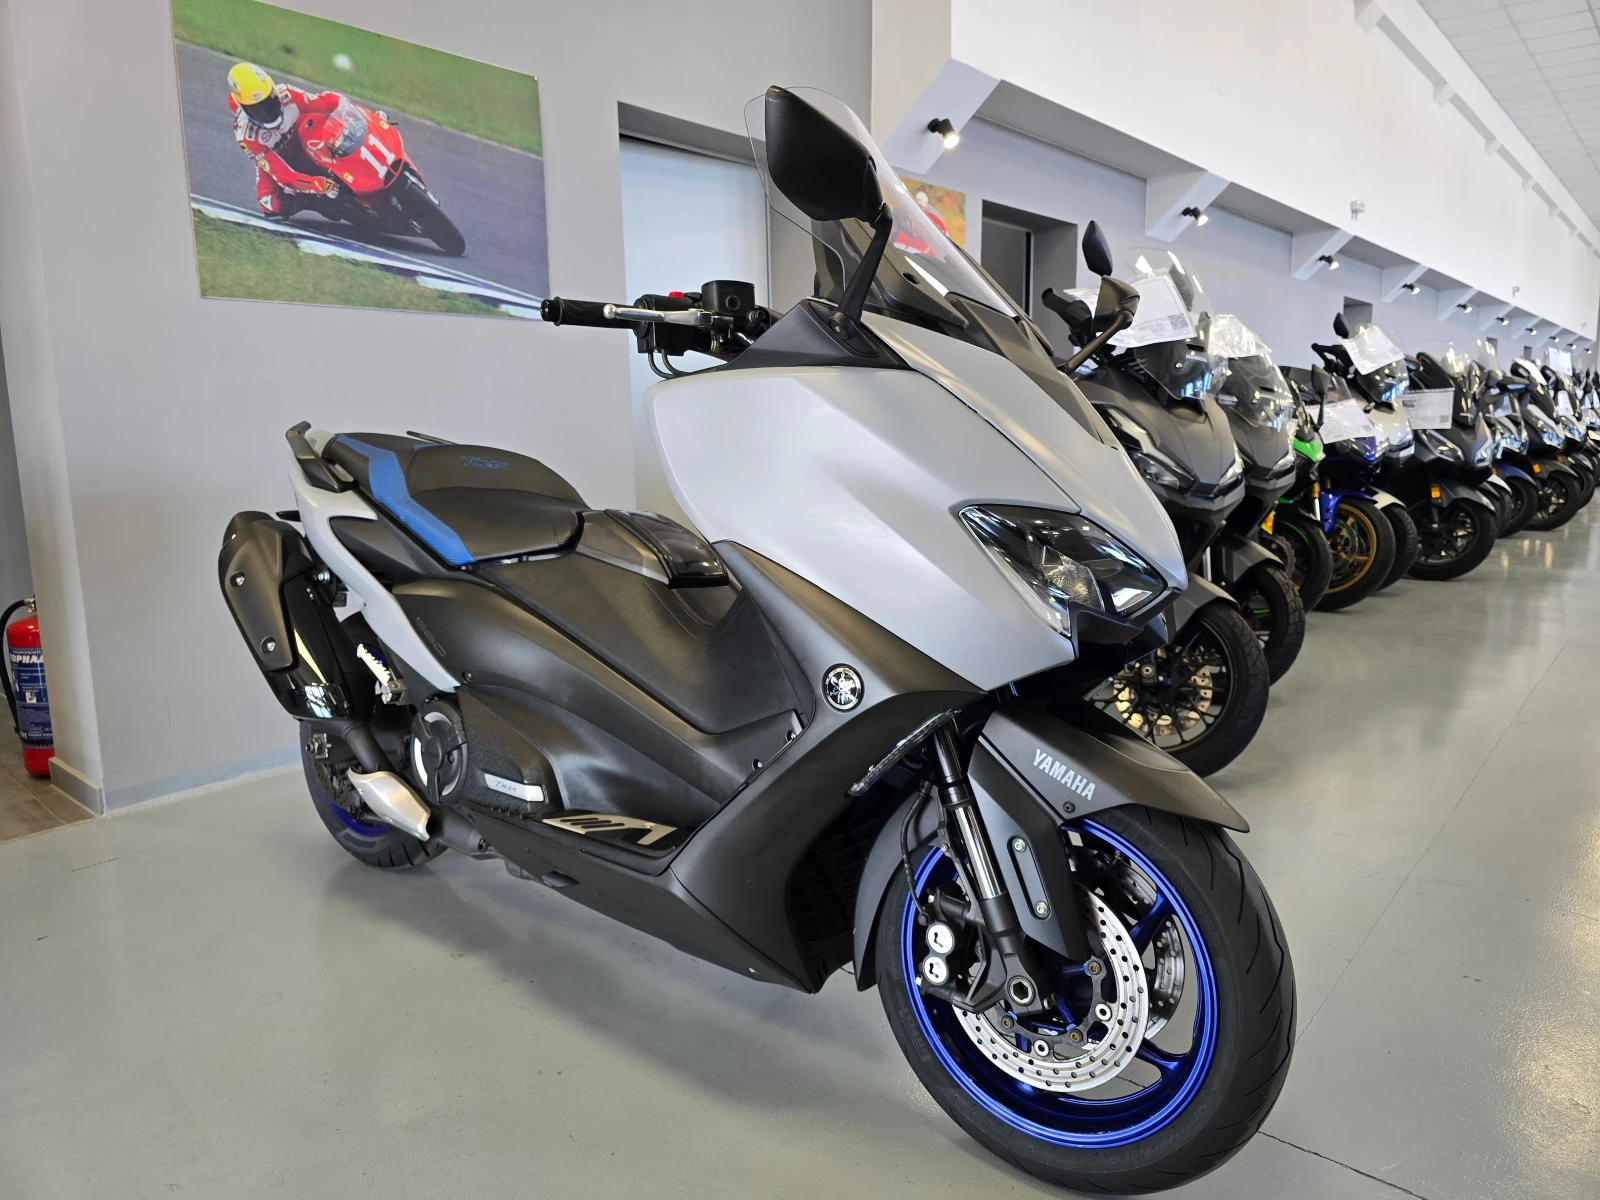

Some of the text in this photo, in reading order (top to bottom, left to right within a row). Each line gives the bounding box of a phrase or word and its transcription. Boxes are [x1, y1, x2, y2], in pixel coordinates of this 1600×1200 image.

[359, 133, 396, 179] 11
[1032, 748, 1096, 801] YAMAHA
[1171, 871, 1221, 946] ROSSO
